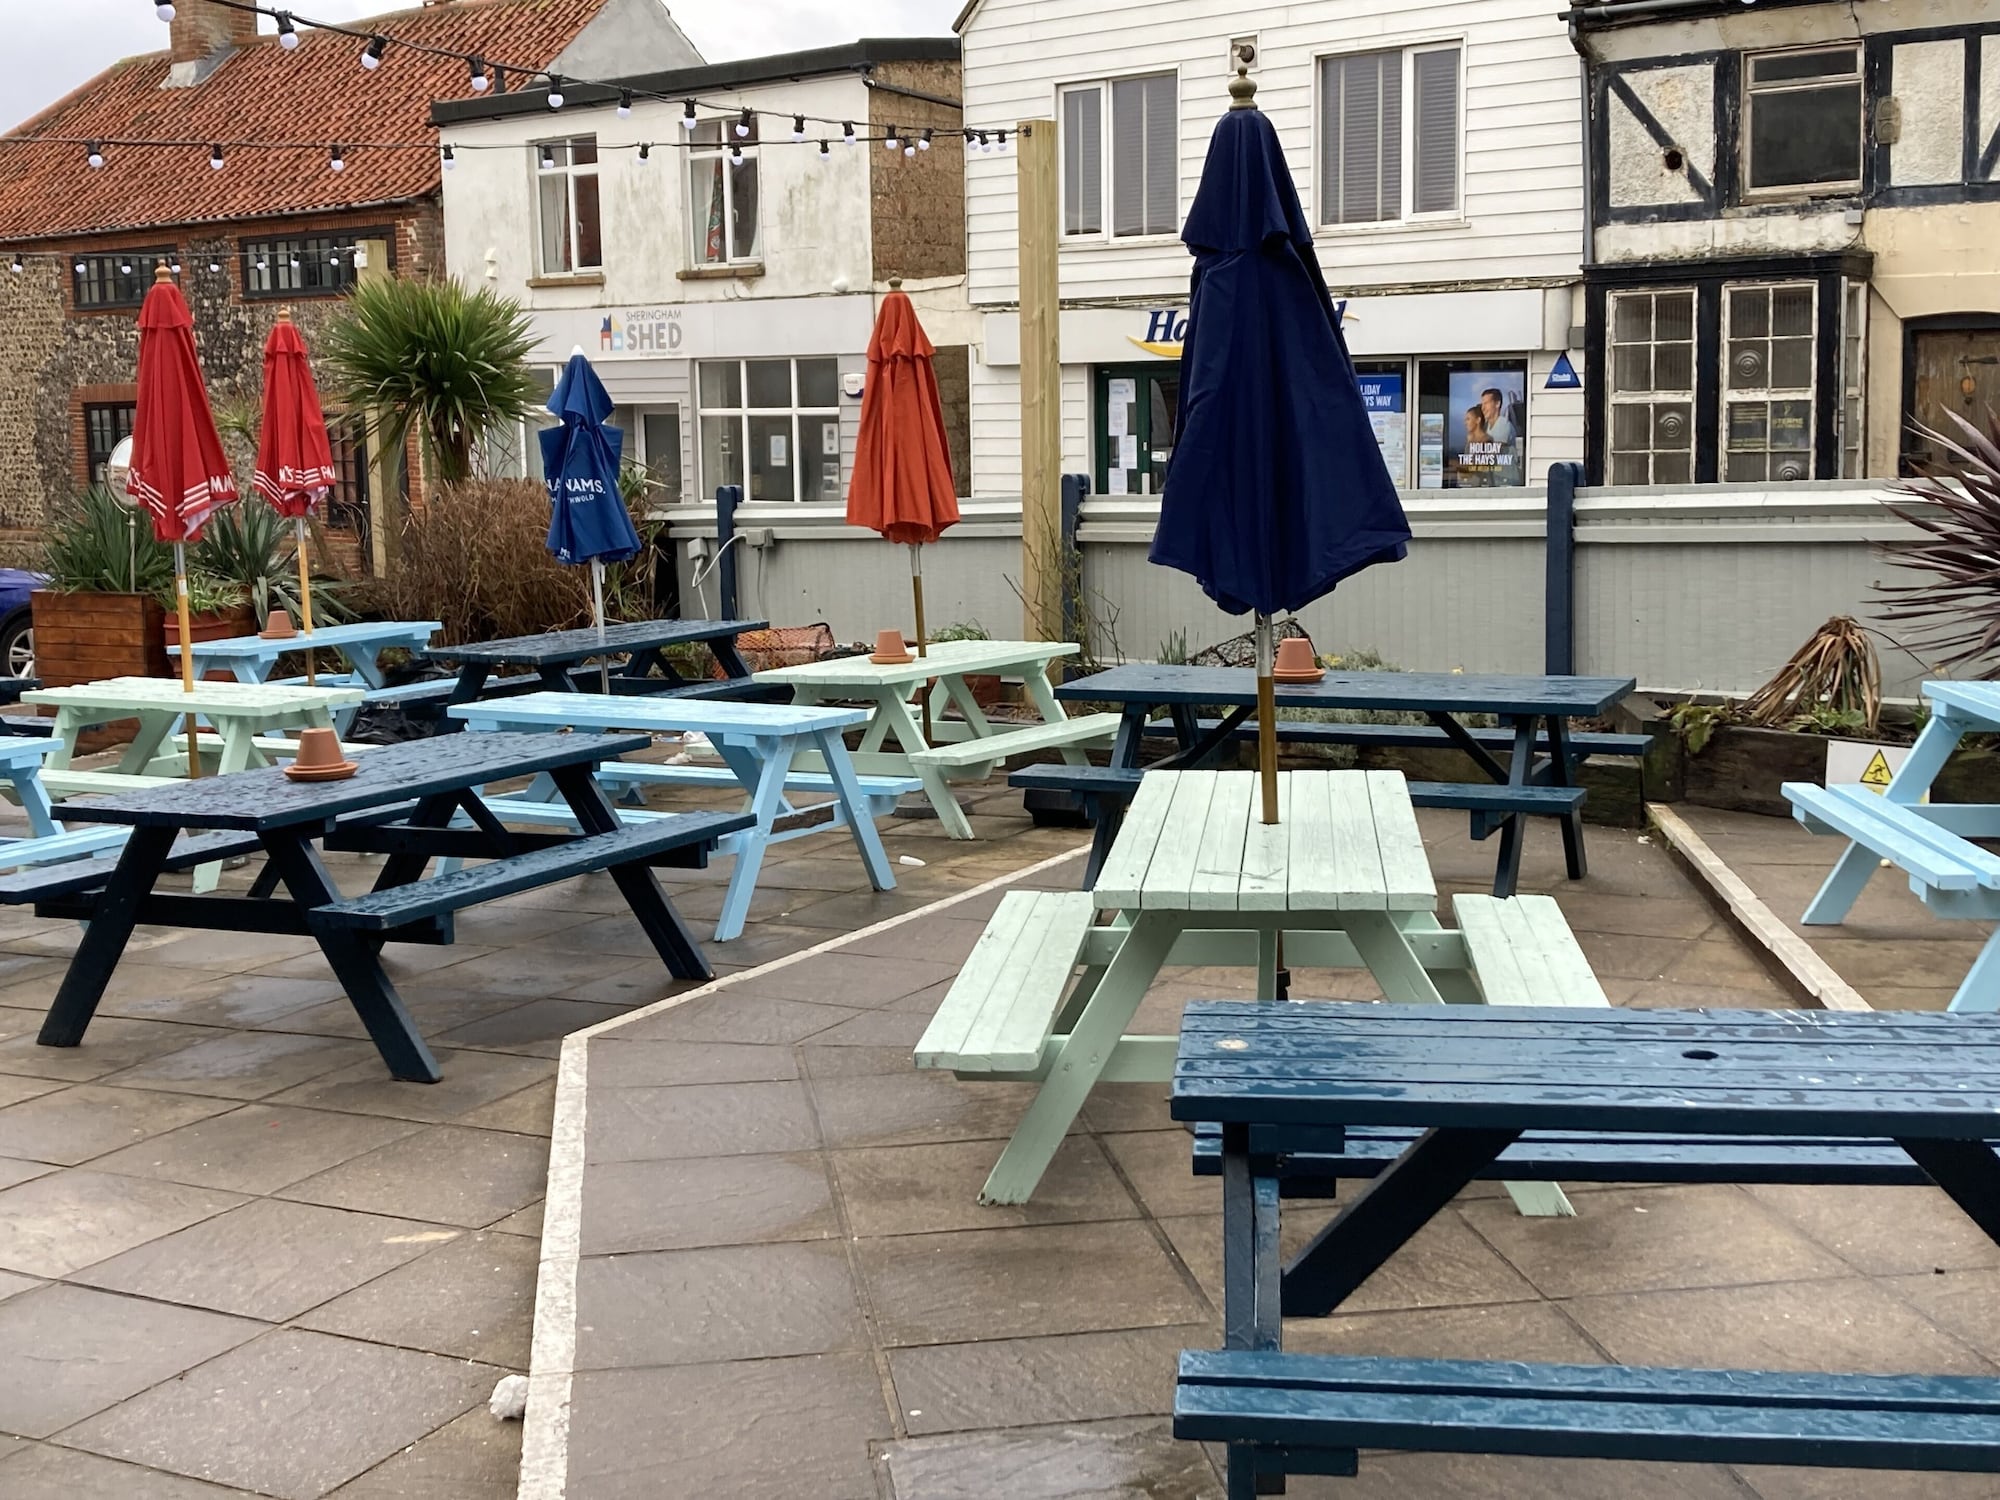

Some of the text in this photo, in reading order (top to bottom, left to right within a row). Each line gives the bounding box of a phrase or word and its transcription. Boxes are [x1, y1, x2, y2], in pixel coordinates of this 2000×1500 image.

[626, 309, 682, 322] SHERINGHAM
[626, 322, 682, 350] SHED
[1360, 384, 1381, 396] LIDAY
[1376, 396, 1392, 407] WAY
[1469, 442, 1502, 453] HOLIDAY
[1458, 454, 1513, 466] THE HAYS WAY
